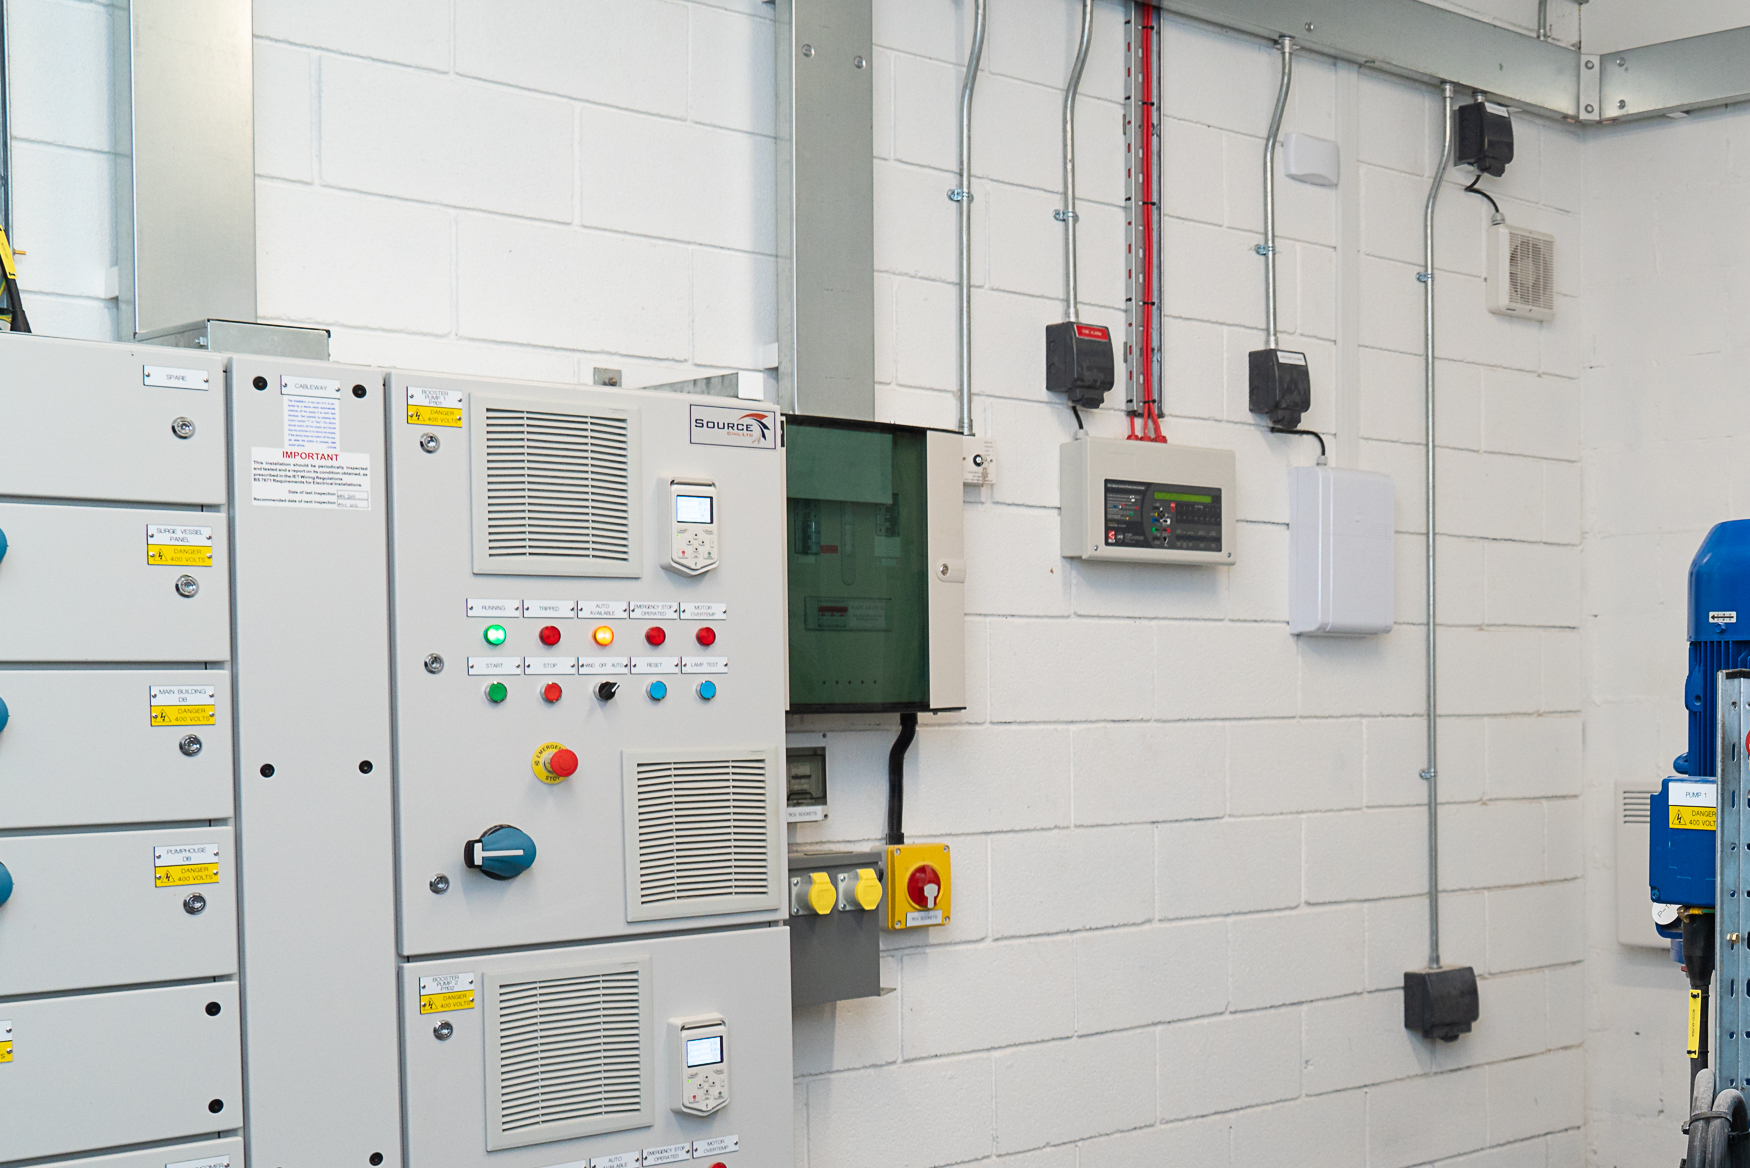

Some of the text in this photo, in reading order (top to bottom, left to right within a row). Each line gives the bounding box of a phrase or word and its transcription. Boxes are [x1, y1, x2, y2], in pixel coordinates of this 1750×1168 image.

[165, 374, 187, 382] SPARE
[294, 383, 328, 391] CABLEWAY
[694, 418, 754, 432] SOURCE
[282, 451, 340, 461] IMPORTANT
[1685, 791, 1702, 799] PUMP
[1691, 810, 1717, 818] DANGER
[1701, 819, 1717, 827] VOLT
[167, 847, 207, 855] PUMPHOUSE
[432, 975, 460, 983] BOOSTER
[443, 993, 467, 1001] DANGER
[707, 1139, 725, 1147] MOTOR
[646, 1145, 686, 1157] EMERGENCY STOP
[703, 1145, 729, 1154] OVERTEMP
[653, 1154, 680, 1162] OPERATED
